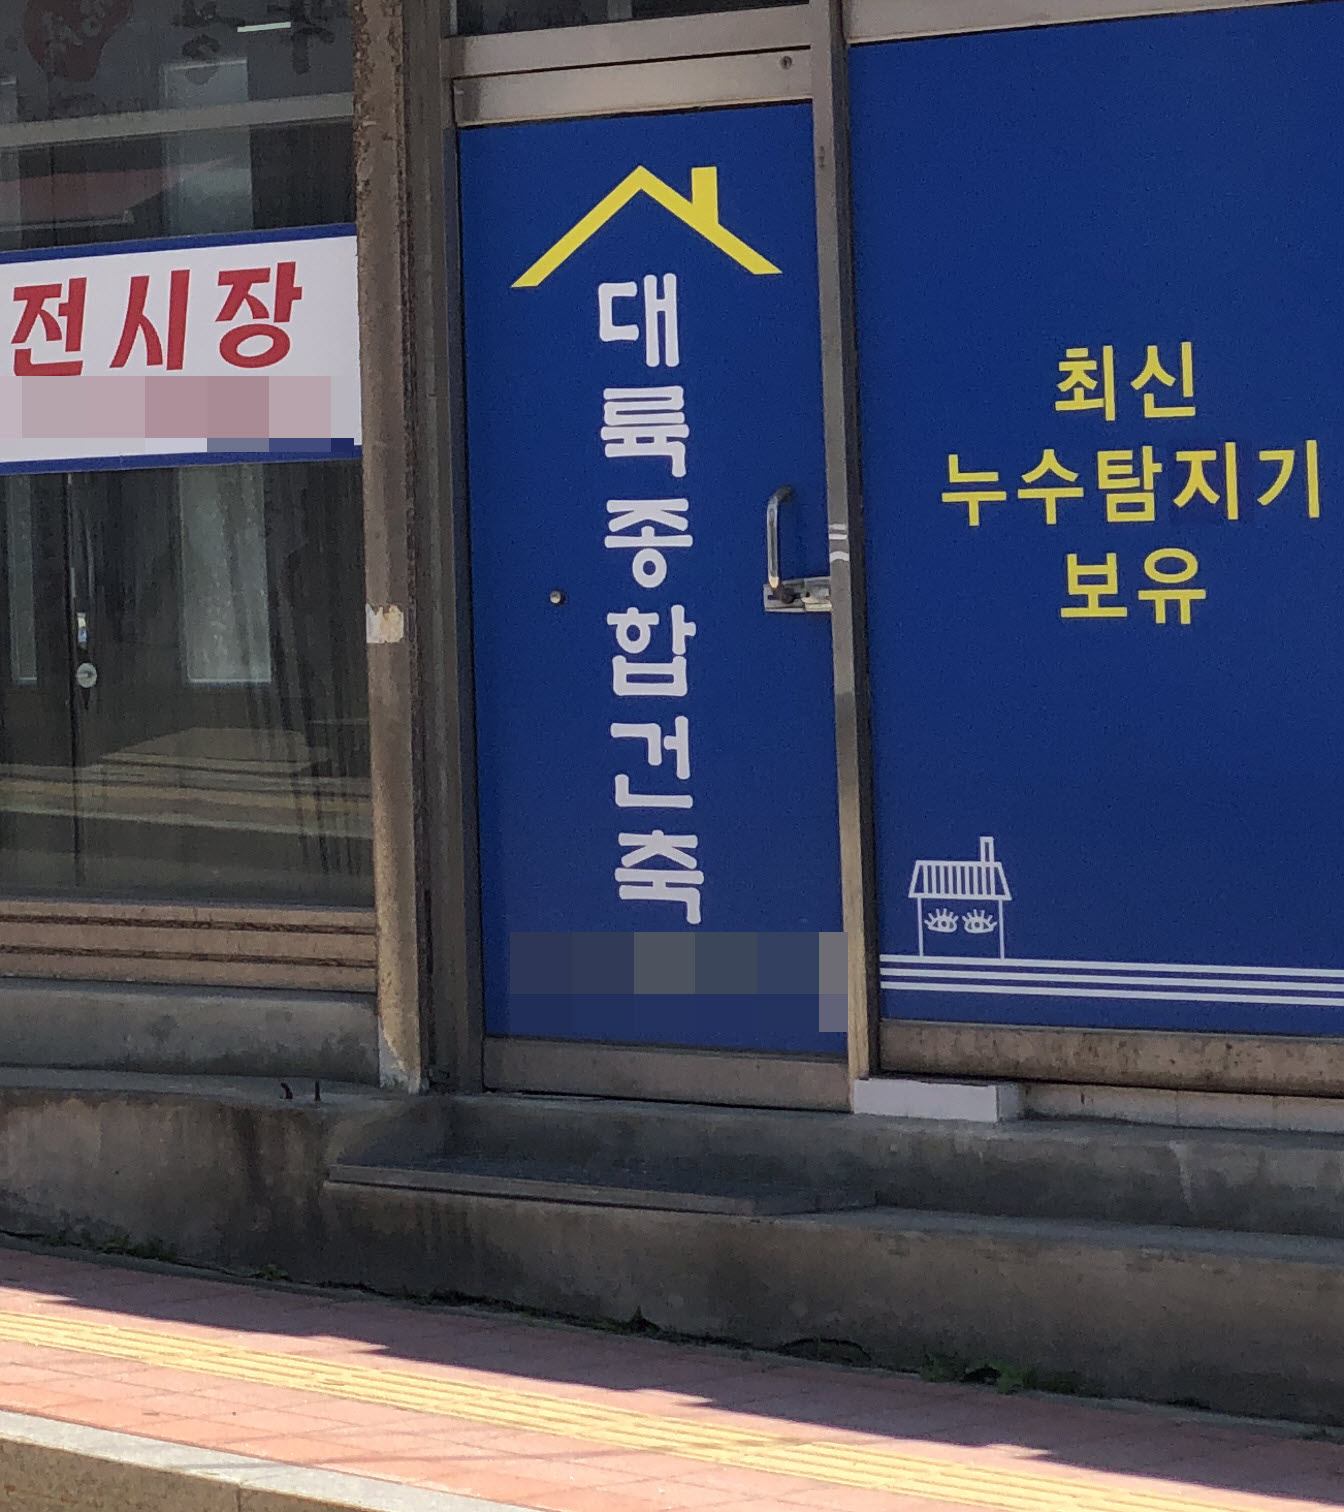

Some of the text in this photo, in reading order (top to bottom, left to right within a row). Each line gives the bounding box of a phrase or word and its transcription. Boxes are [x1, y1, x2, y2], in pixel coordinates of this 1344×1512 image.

[11, 261, 303, 377] 전시장
[1054, 340, 1199, 422] 최신
[940, 439, 1323, 527] 누수탐지기
[596, 272, 705, 926] 대륙종합건축
[1060, 547, 1208, 626] 보유
